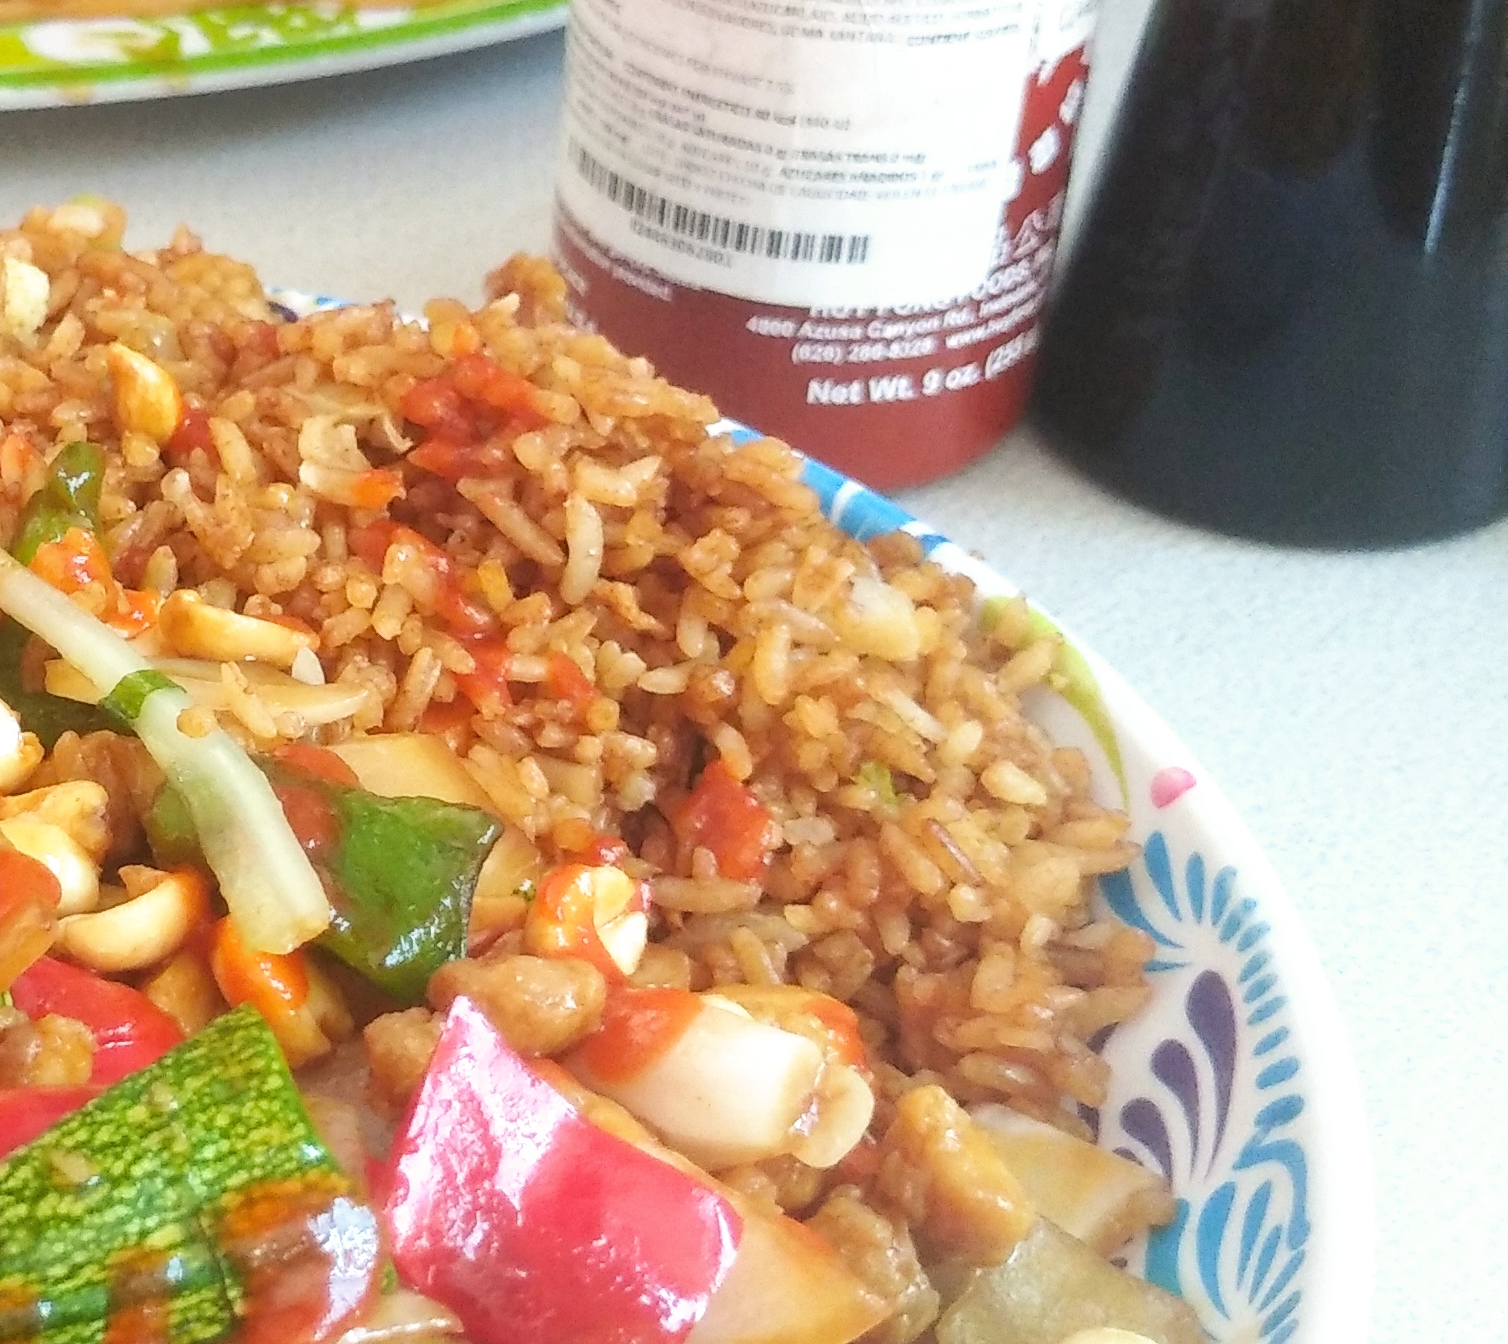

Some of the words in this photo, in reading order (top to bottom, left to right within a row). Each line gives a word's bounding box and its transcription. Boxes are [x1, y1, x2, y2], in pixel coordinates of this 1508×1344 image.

[866, 314, 941, 340] Canyon
[806, 377, 865, 405] Net
[922, 367, 943, 396] 9
